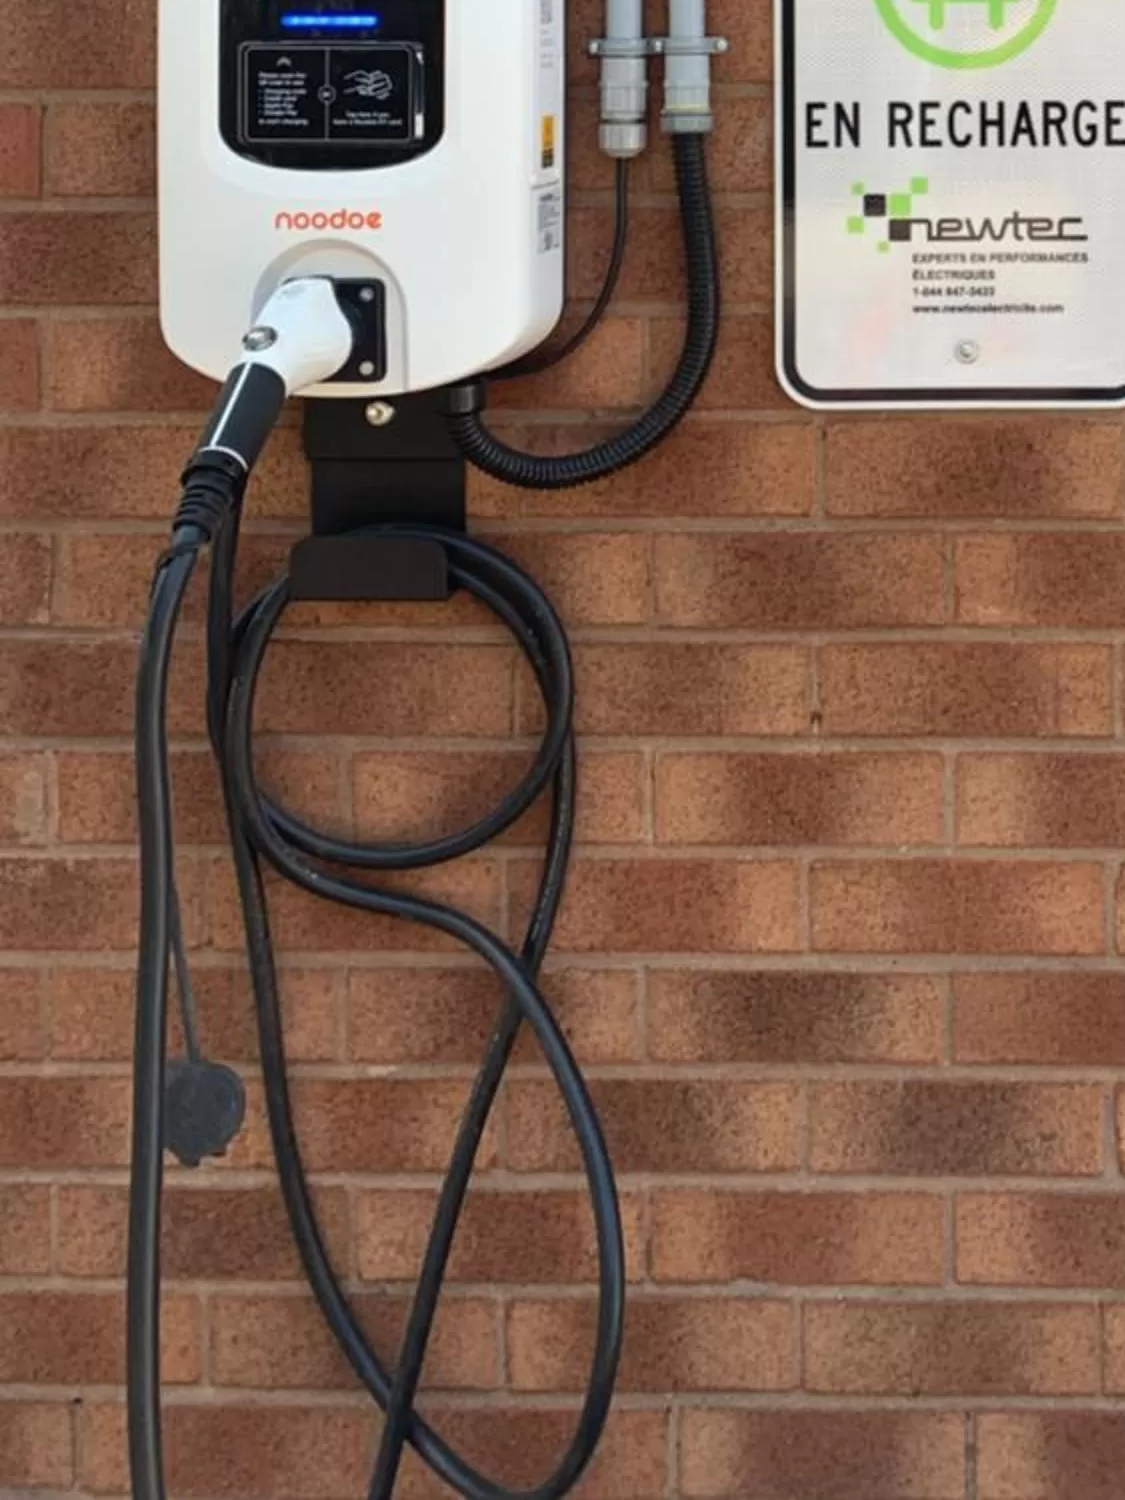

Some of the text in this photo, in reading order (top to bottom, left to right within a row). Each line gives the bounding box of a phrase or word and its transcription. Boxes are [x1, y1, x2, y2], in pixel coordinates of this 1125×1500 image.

[805, 99, 860, 149] EN
[274, 208, 383, 230] noodoe
[889, 210, 1089, 242] newtec
[912, 252, 1089, 264] EXPERTS EN PERFORMANCES
